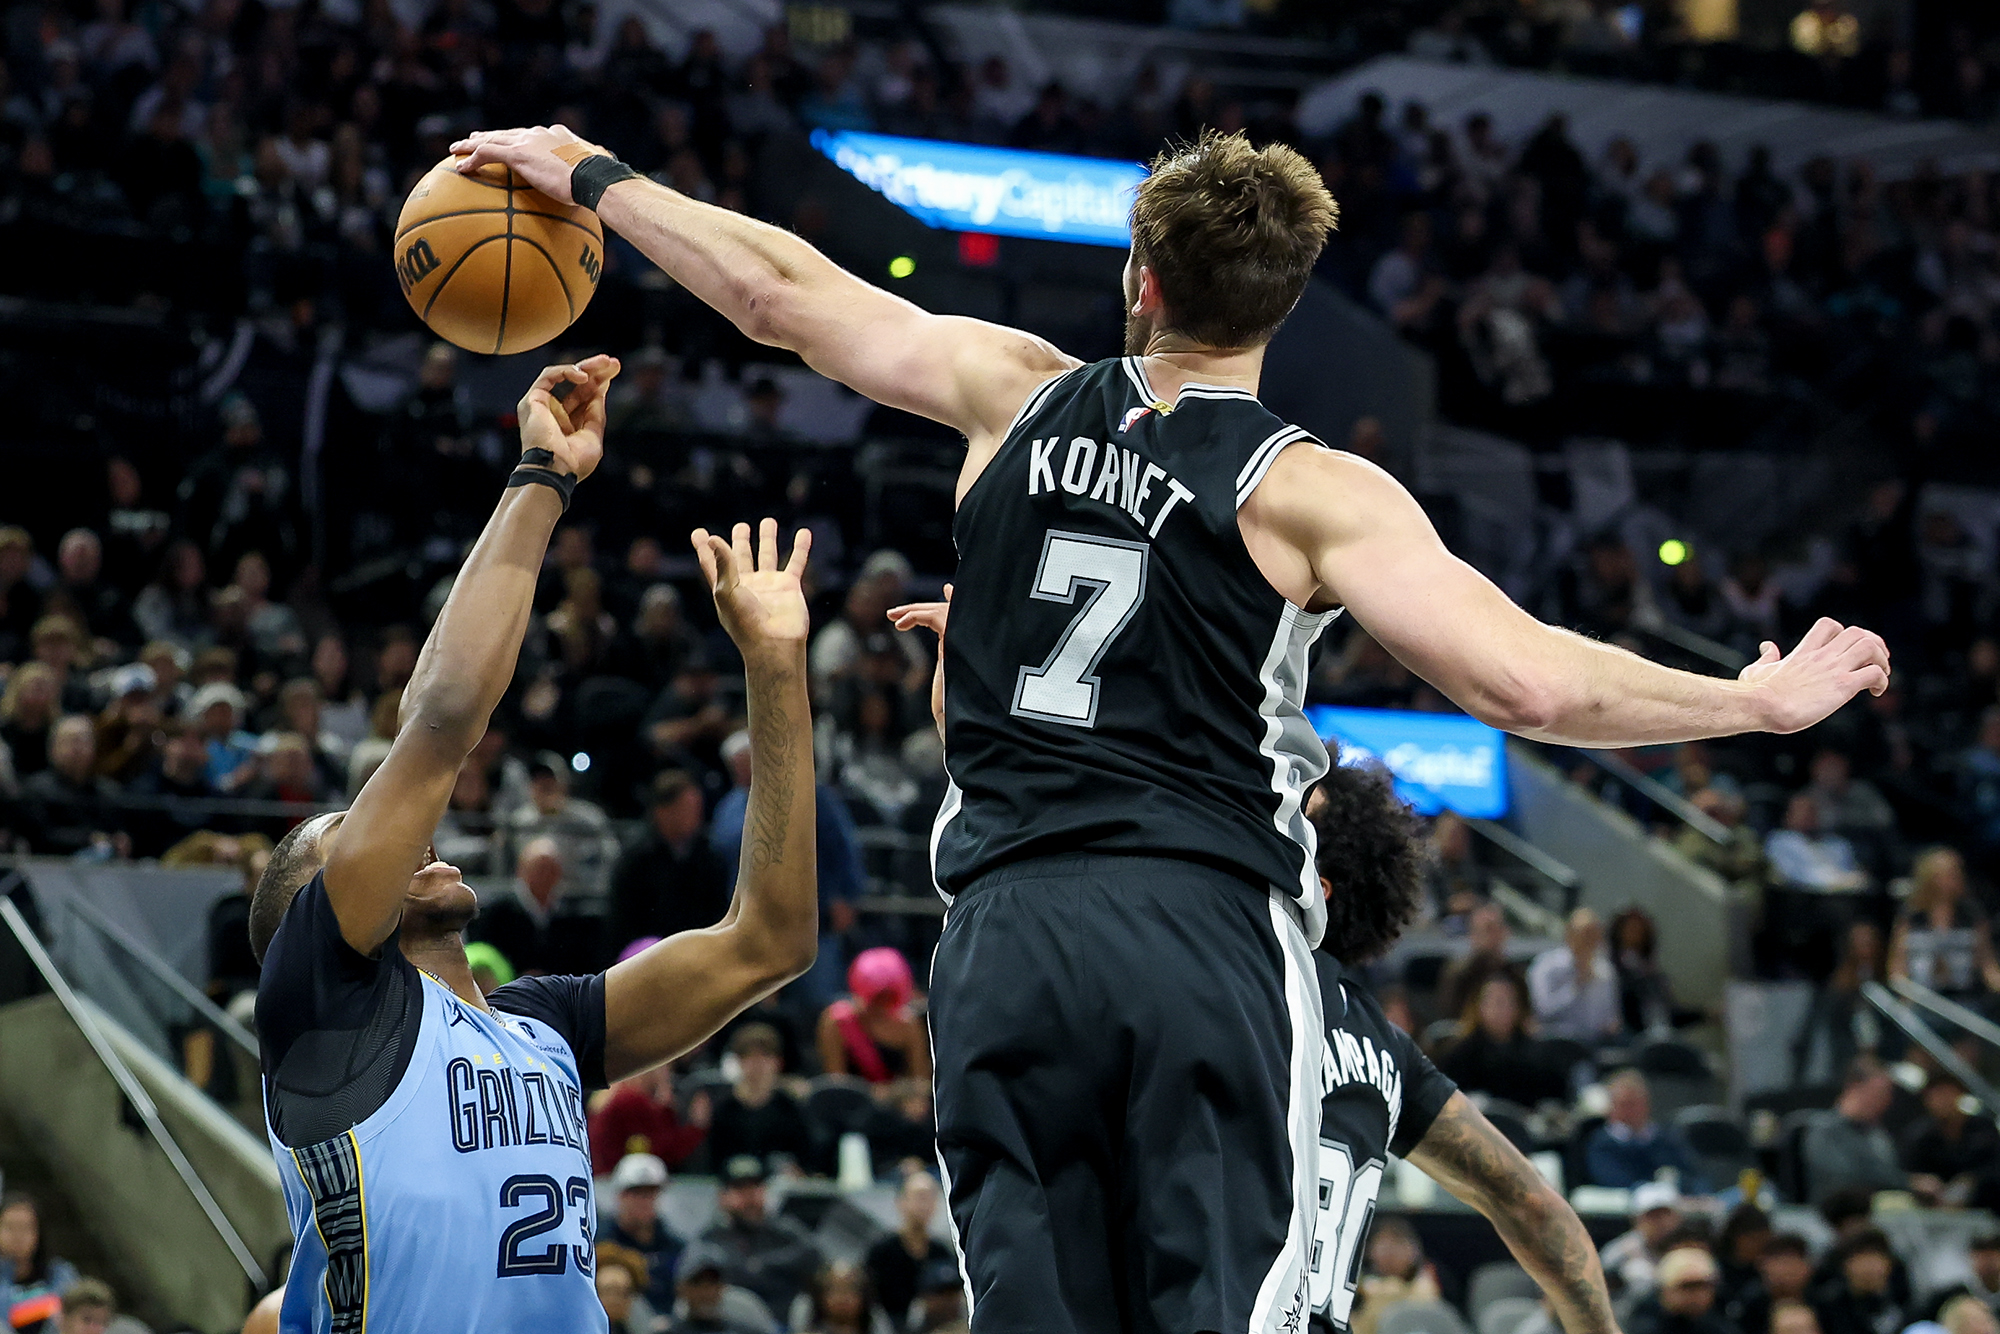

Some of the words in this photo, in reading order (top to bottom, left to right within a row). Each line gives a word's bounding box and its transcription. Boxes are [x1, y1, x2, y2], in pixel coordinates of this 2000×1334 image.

[1028, 436, 1195, 539] KORNET
[1010, 529, 1150, 728] 7
[473, 1053, 564, 1077] MEPHI
[497, 1173, 593, 1279] 23
